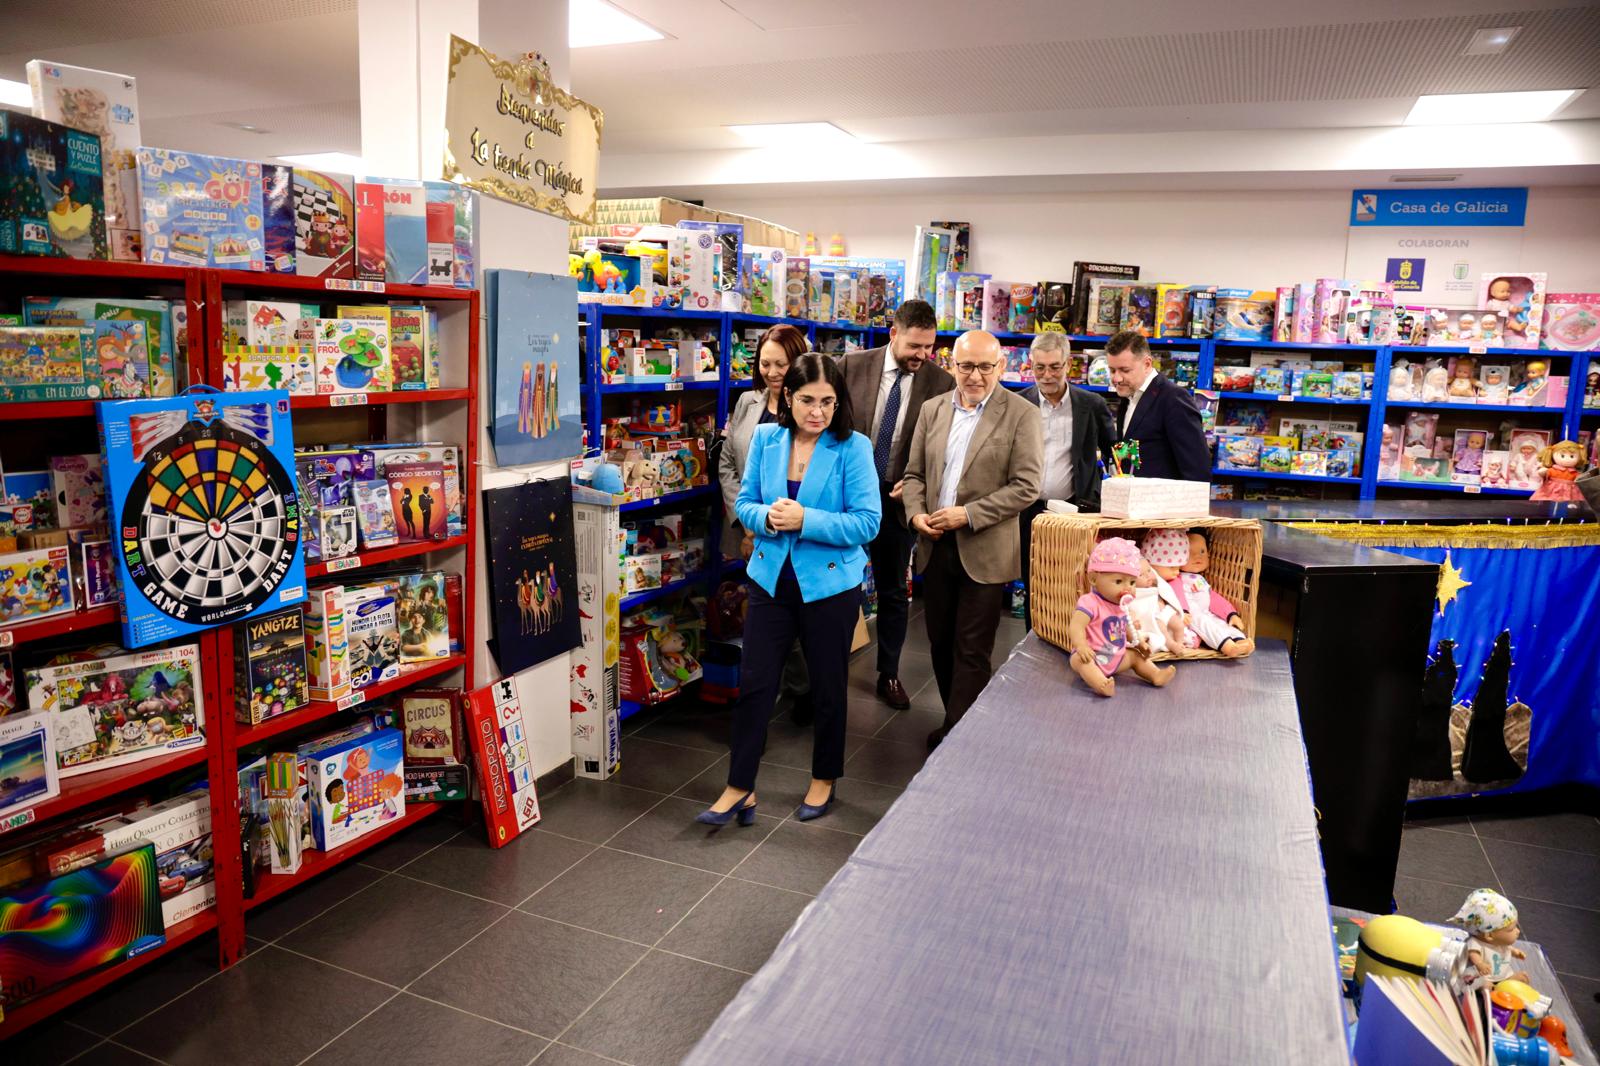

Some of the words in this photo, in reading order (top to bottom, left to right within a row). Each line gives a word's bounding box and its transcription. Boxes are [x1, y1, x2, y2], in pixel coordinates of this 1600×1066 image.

[497, 83, 565, 136] Bienvenidos
[67, 138, 99, 155] CUENTO
[525, 131, 535, 149] a
[76, 152, 97, 164] PUZLE
[471, 126, 489, 166] La
[493, 143, 532, 180] tienda
[535, 159, 583, 197] Mágica
[204, 178, 250, 206] GO!
[1390, 201, 1427, 213] Casa
[1431, 201, 1450, 213] de
[1454, 200, 1509, 213] Galicia
[1398, 239, 1470, 248] COLABORAN
[46, 387, 56, 398] EN
[59, 387, 67, 397] EL
[71, 387, 85, 397] ZOO
[201, 429, 211, 438] 20
[152, 451, 162, 462] 12
[283, 492, 298, 542] GAME
[123, 526, 146, 578] DART
[262, 550, 293, 593] DART
[143, 581, 189, 620] GAME
[201, 610, 224, 623] WORLD
[377, 613, 391, 621] FLOTA
[251, 615, 300, 640] YANGTZE
[179, 648, 194, 657] 104
[351, 670, 372, 689] GO!
[407, 704, 446, 722] CIRCUS
[480, 718, 507, 814] MONOPOLIO
[523, 796, 535, 818] GO
[110, 836, 133, 850] HIGH
[133, 822, 167, 841] QUALITY
[167, 805, 211, 826] COLLECTIO
[173, 895, 216, 921] Clemento
